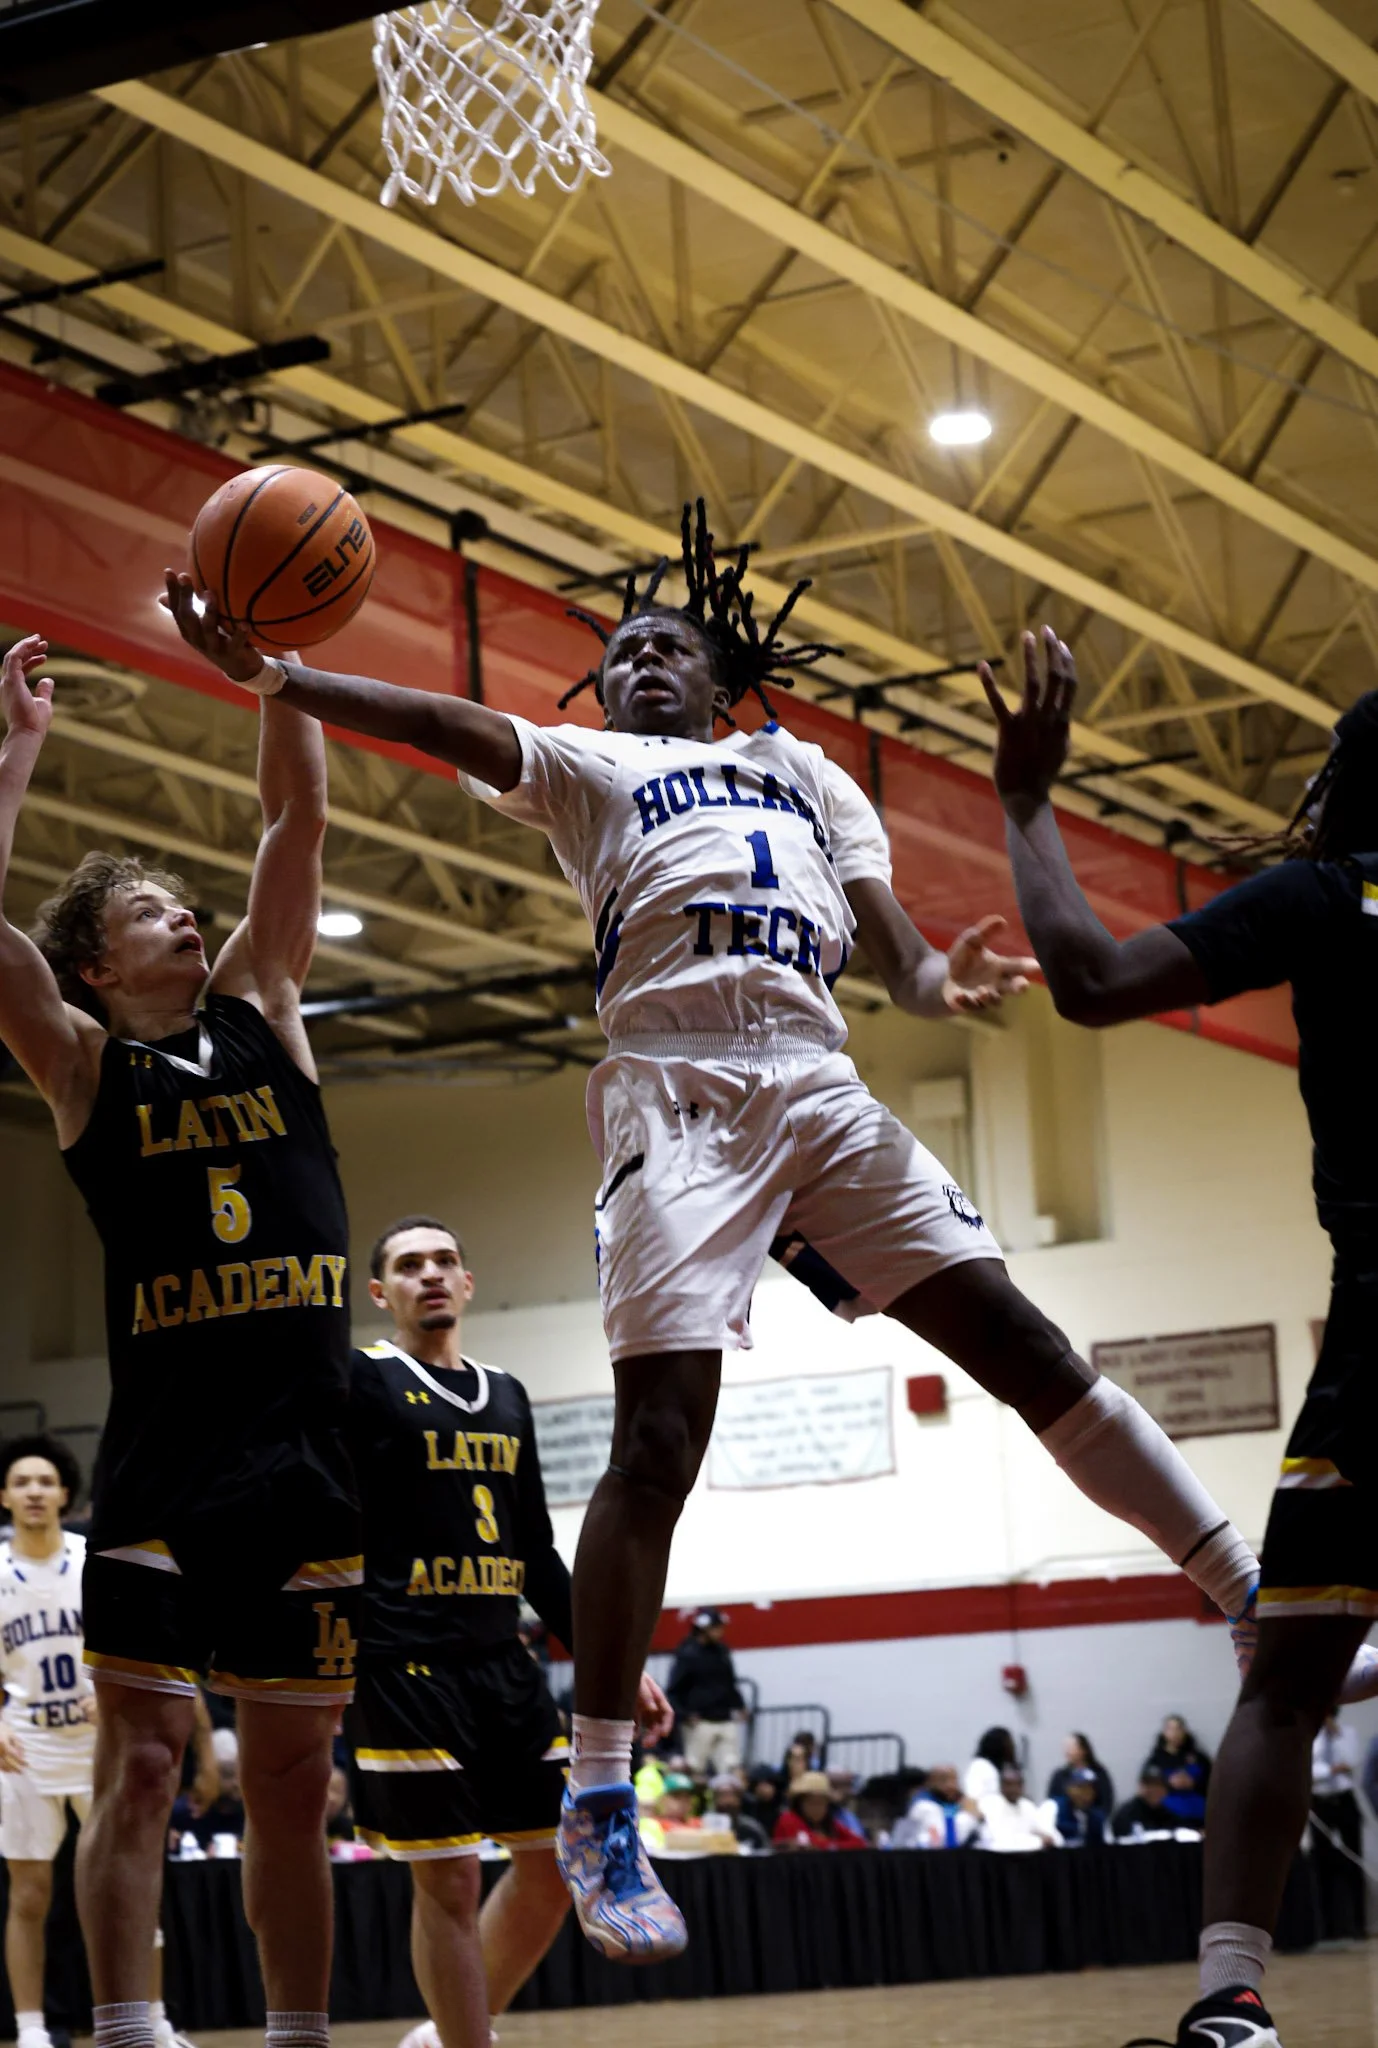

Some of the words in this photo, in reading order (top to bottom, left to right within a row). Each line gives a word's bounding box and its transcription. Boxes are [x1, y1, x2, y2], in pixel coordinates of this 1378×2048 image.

[302, 517, 367, 598] ELITE
[744, 830, 780, 890] 1
[683, 902, 822, 977] TECH
[136, 1085, 288, 1157] LATIN
[206, 1163, 252, 1243] 5
[131, 1254, 347, 1336] ACADEMY
[422, 1430, 520, 1476] LATIN
[471, 1483, 499, 1544] 3
[3, 1609, 84, 1655] HOLLAN
[311, 1601, 358, 1675] LA
[39, 1653, 77, 1693] 10
[27, 1696, 89, 1728] TEC
